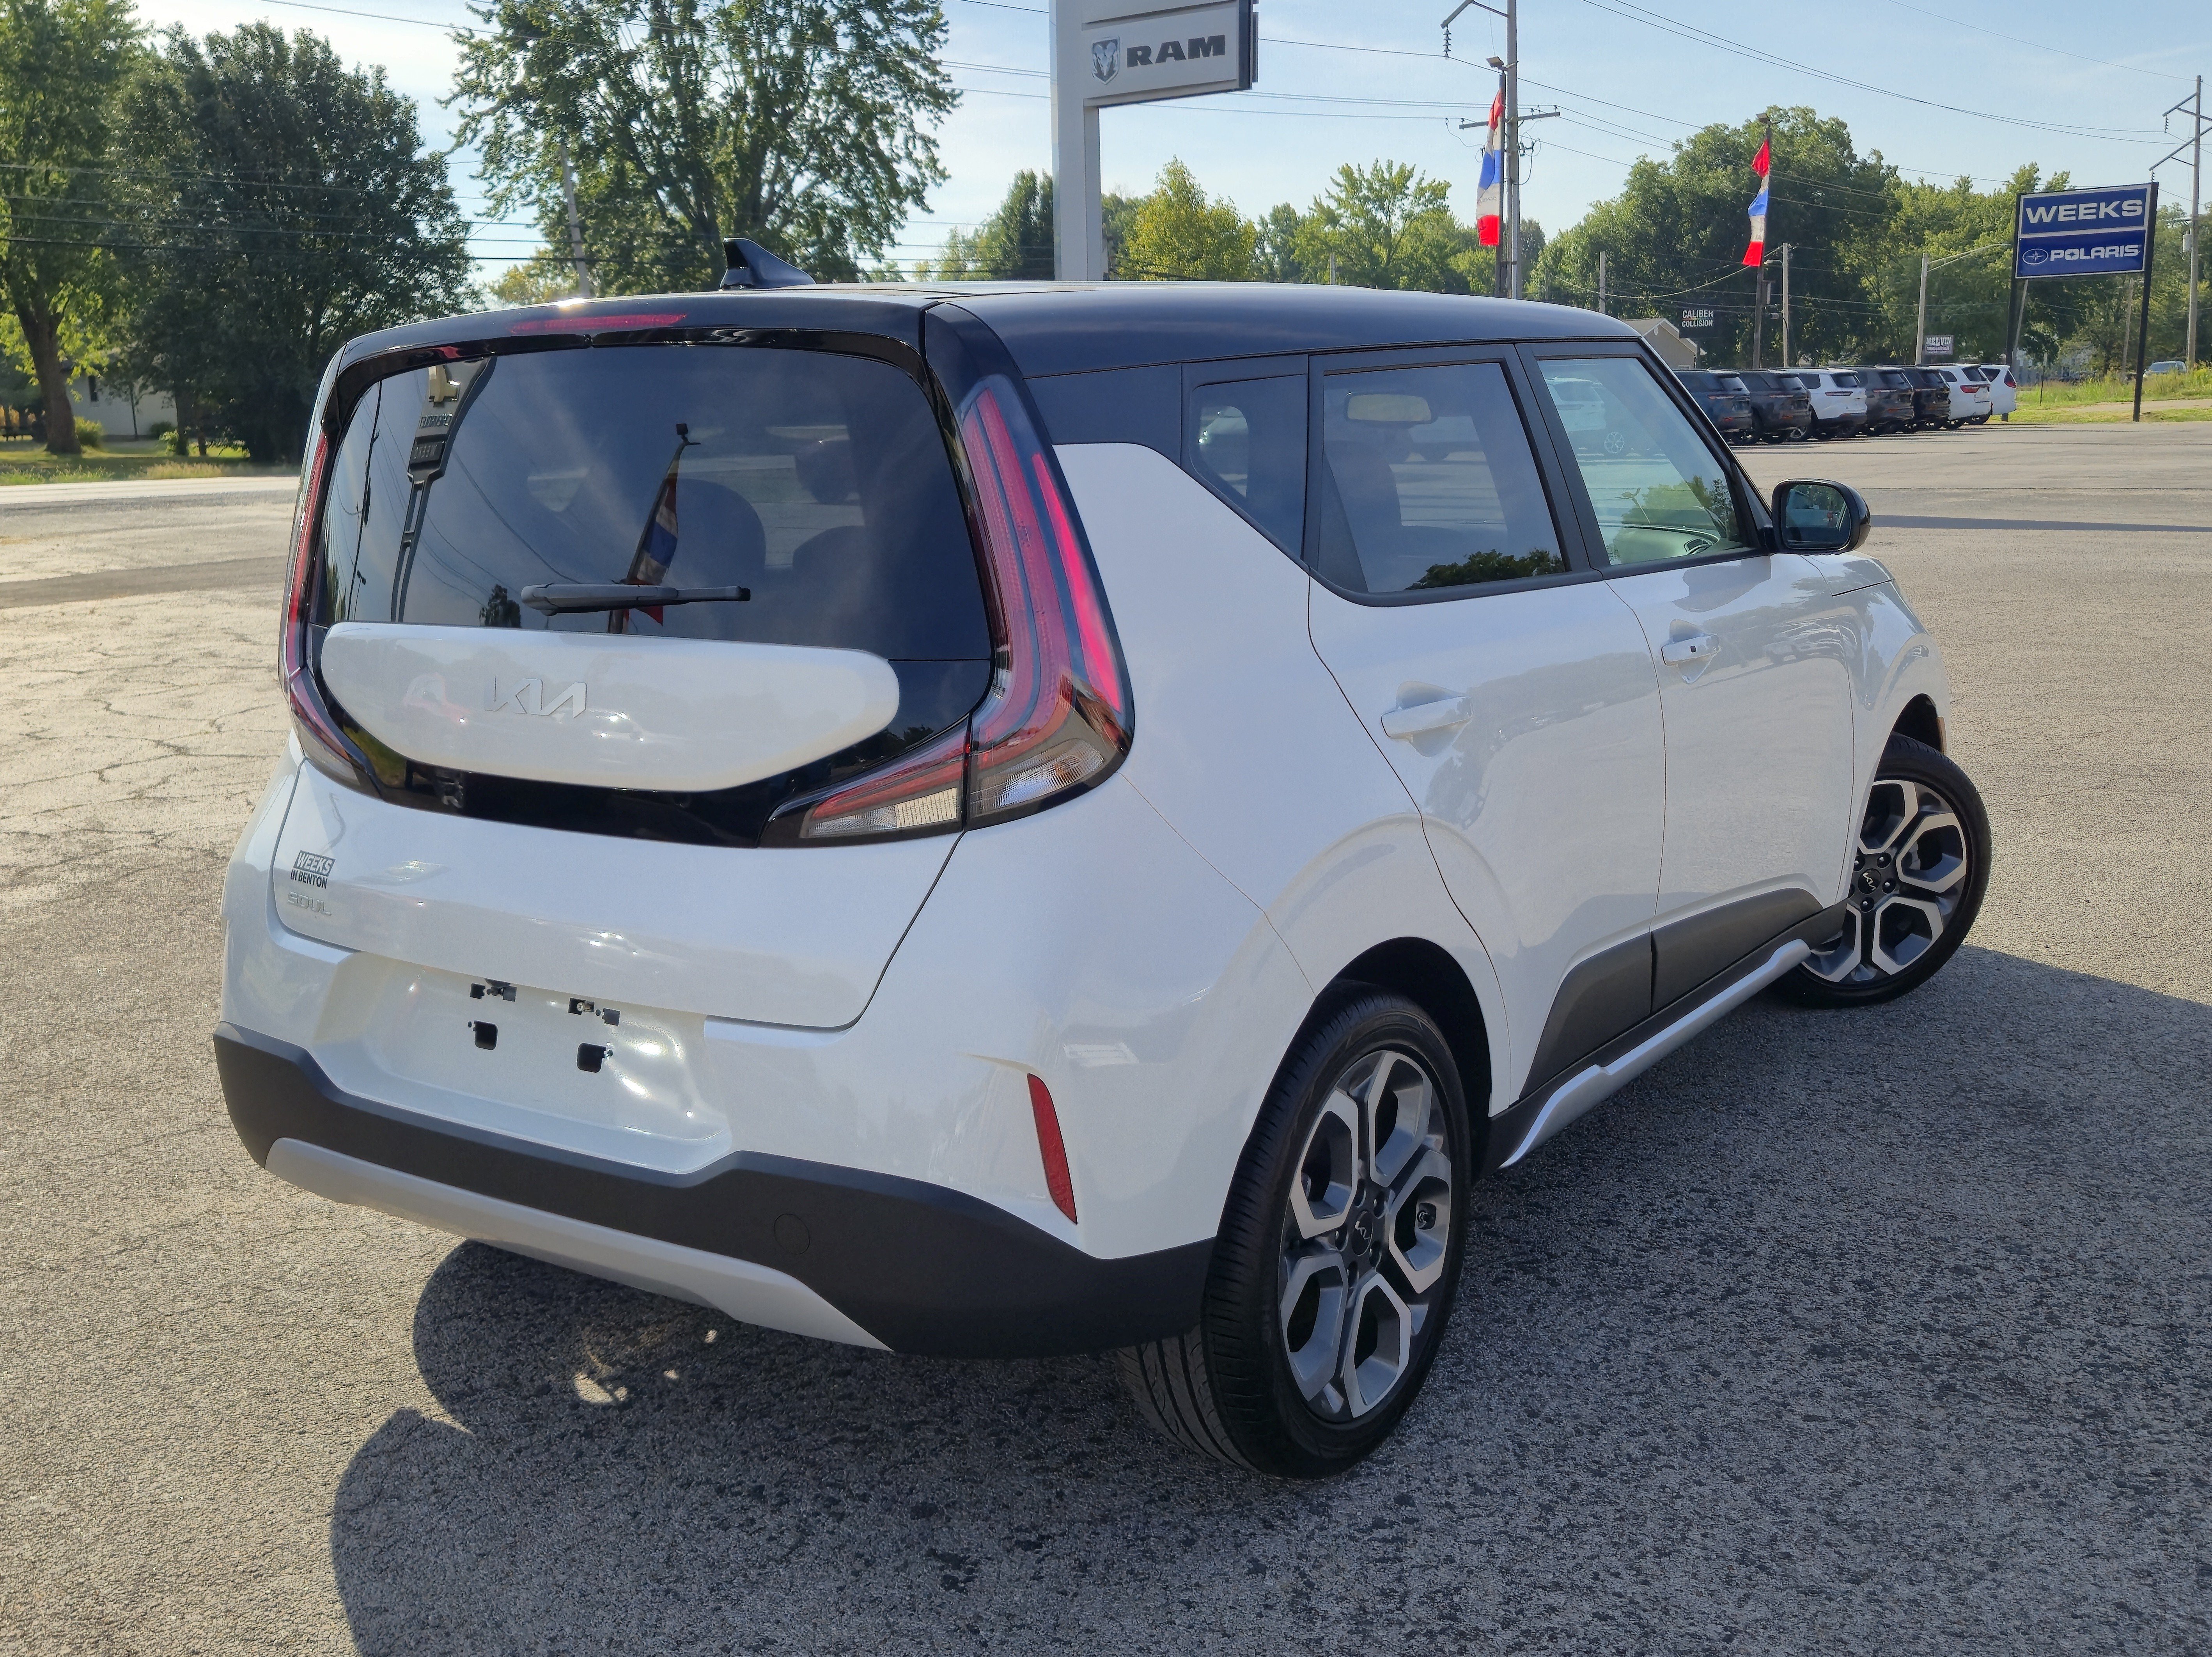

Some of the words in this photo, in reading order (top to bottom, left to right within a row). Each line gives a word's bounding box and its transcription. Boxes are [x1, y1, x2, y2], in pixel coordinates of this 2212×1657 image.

[1126, 34, 1225, 68] RAM
[2025, 199, 2143, 224] WEEKS
[2050, 244, 2139, 262] POLARIS
[1682, 310, 1714, 318] CALIBER
[484, 675, 588, 719] KIA
[297, 852, 333, 874] WEEKS
[290, 869, 298, 880] IN
[298, 871, 328, 889] BENTON
[287, 891, 332, 916] SOUL
